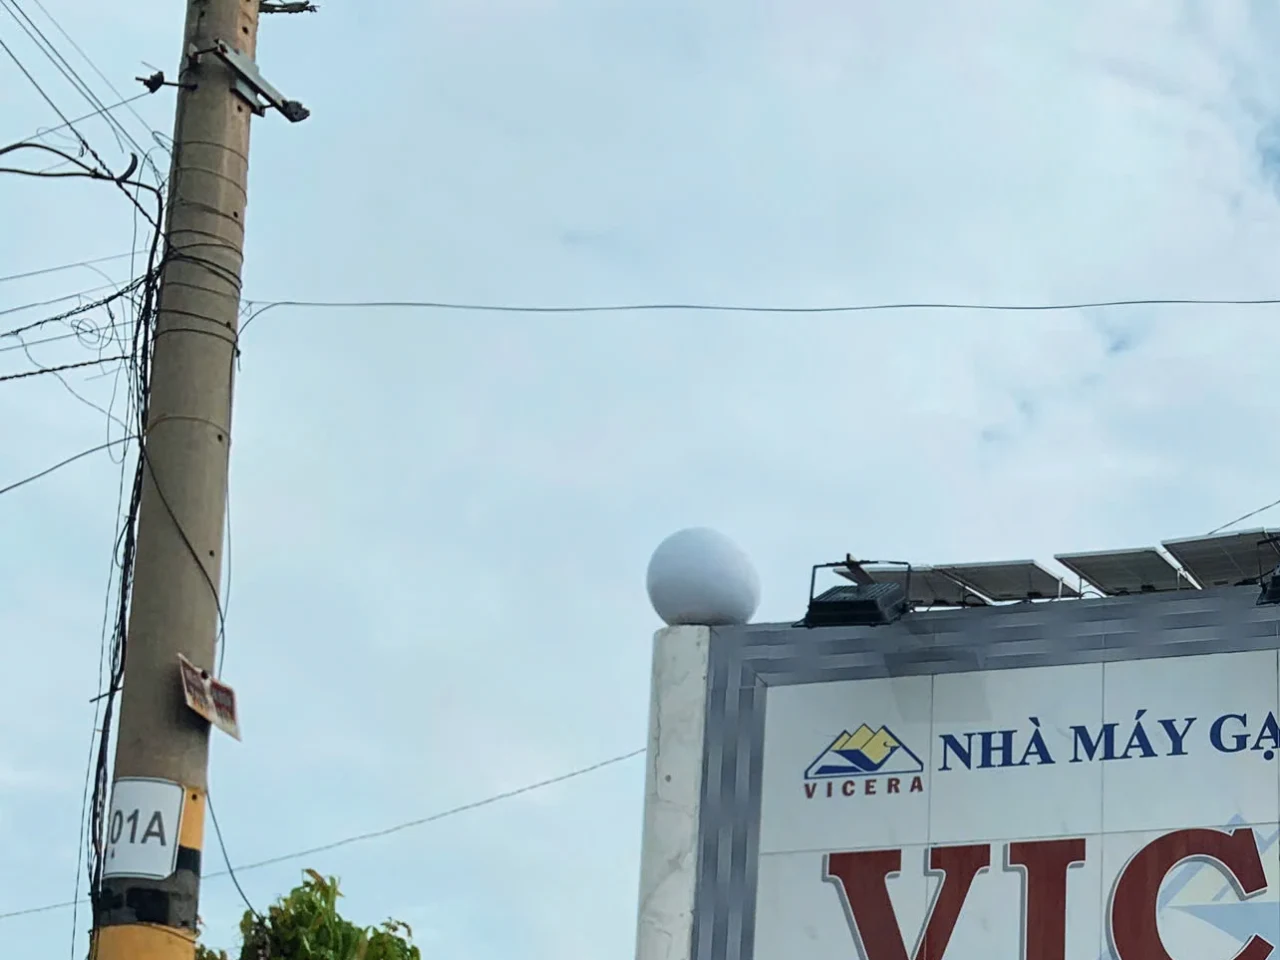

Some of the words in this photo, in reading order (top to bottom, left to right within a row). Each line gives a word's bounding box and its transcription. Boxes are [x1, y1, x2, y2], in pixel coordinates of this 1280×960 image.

[937, 717, 1055, 771] NHÀ
[1068, 709, 1198, 763] MÁY
[803, 775, 923, 799] VICERA
[110, 809, 167, 846] 01A
